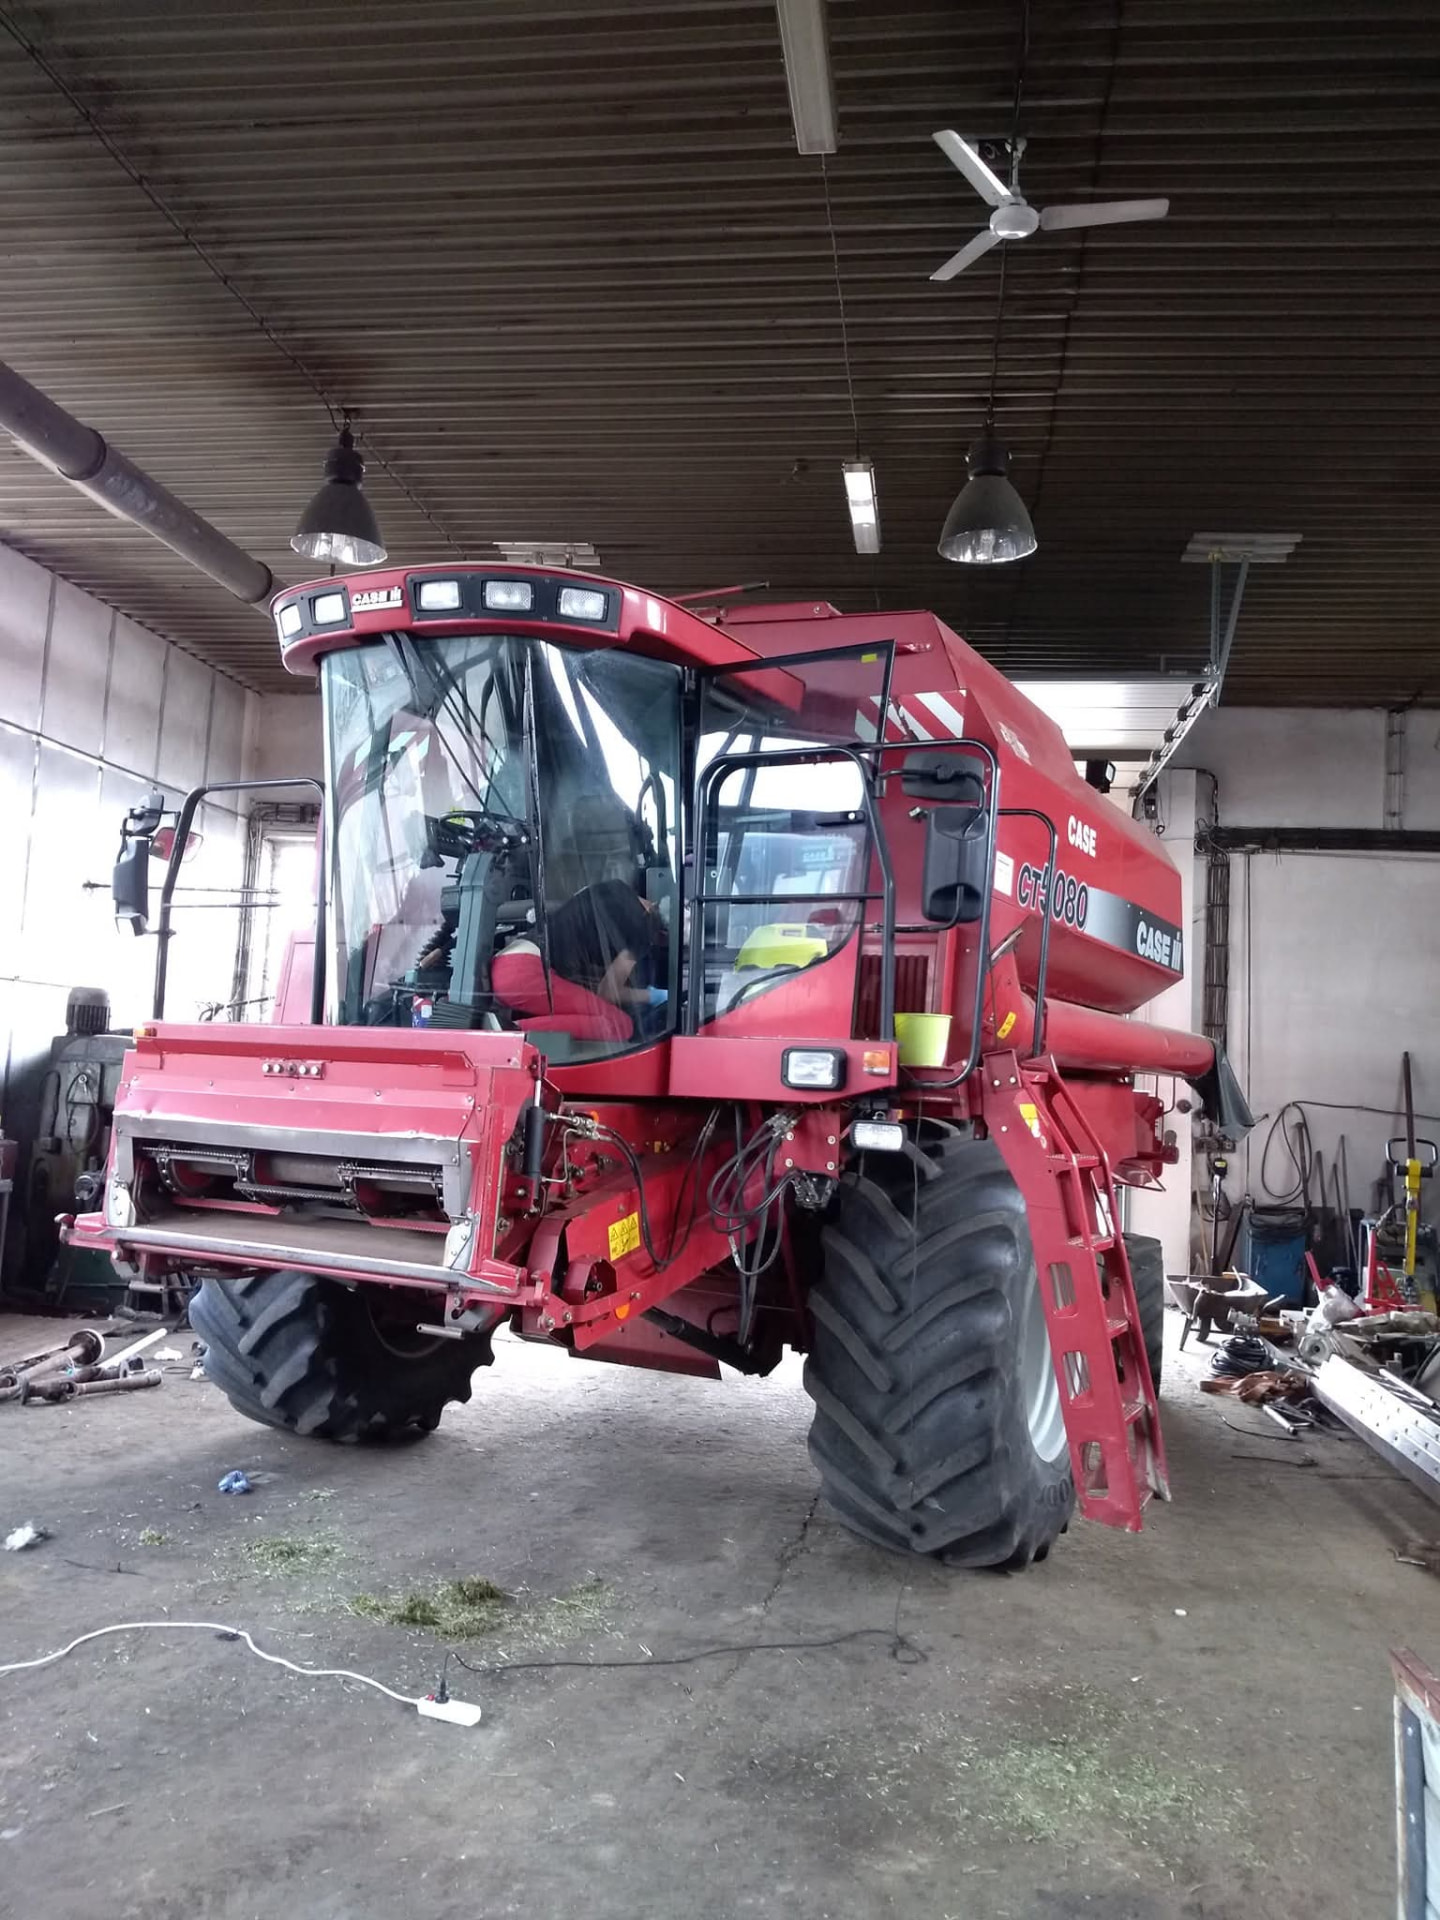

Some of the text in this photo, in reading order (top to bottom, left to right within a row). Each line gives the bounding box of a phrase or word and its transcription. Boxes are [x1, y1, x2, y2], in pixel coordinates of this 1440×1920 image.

[352, 591, 387, 606] CASE
[1068, 815, 1096, 858] CASE
[1136, 920, 1171, 966] CASE
